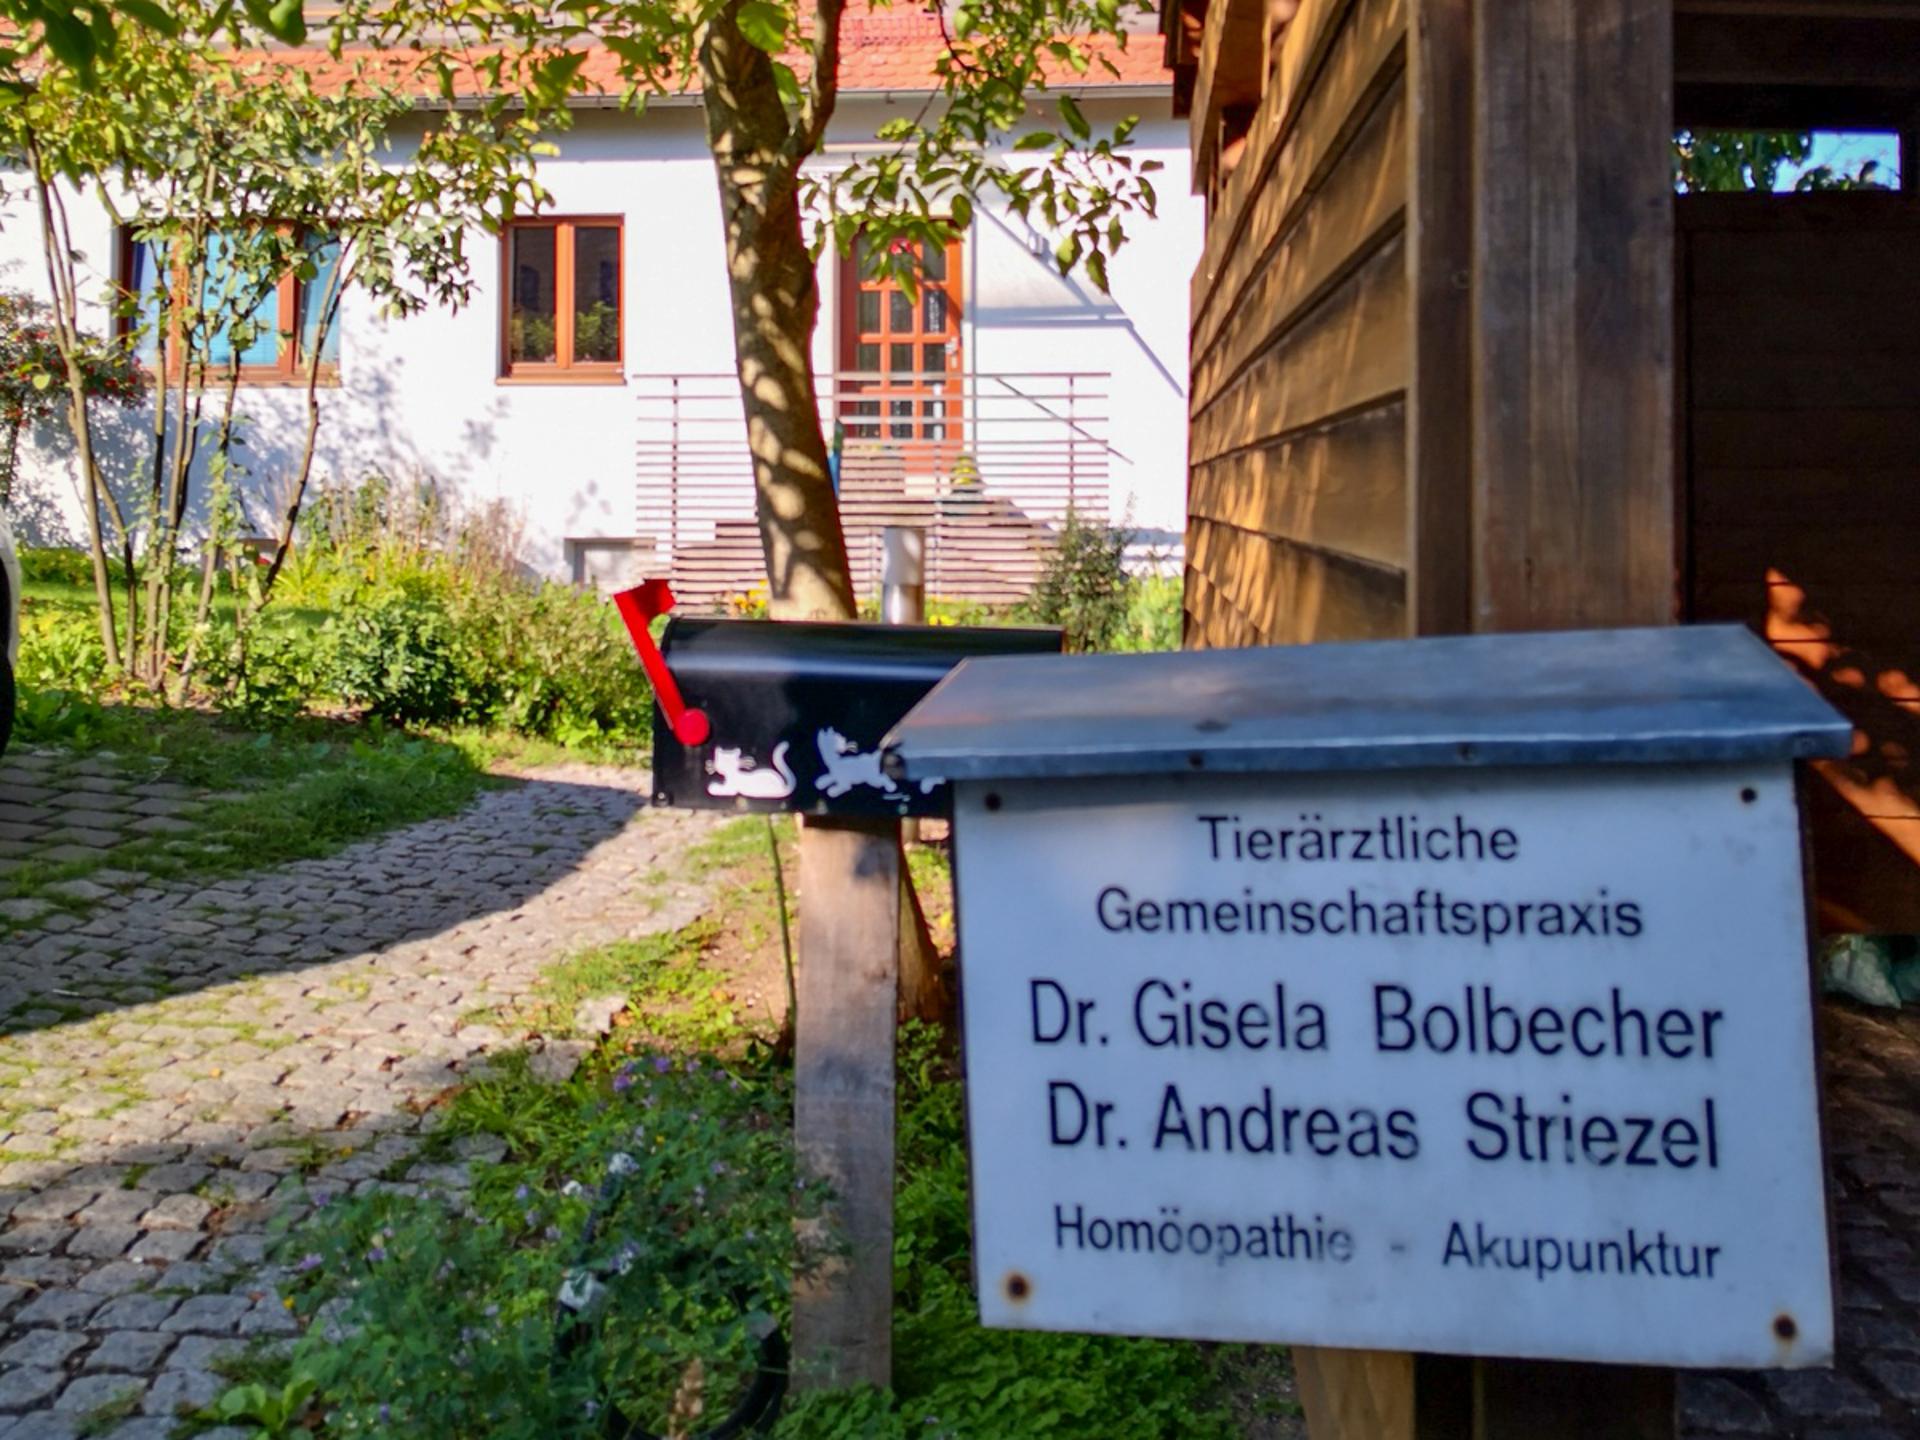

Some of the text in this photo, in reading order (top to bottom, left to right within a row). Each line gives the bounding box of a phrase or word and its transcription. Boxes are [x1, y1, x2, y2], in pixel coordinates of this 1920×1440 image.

[1196, 813, 1519, 862] Tierärztliche
[1095, 885, 1644, 948] Gemeinschaftspraxis
[1028, 976, 1725, 1061] Dr. Gisela Bolbecher
[1047, 1080, 1720, 1170] Dr. Andreas Striezel
[1053, 1202, 1355, 1266] Homöopathie
[1441, 1219, 1723, 1281] Akupunktur
